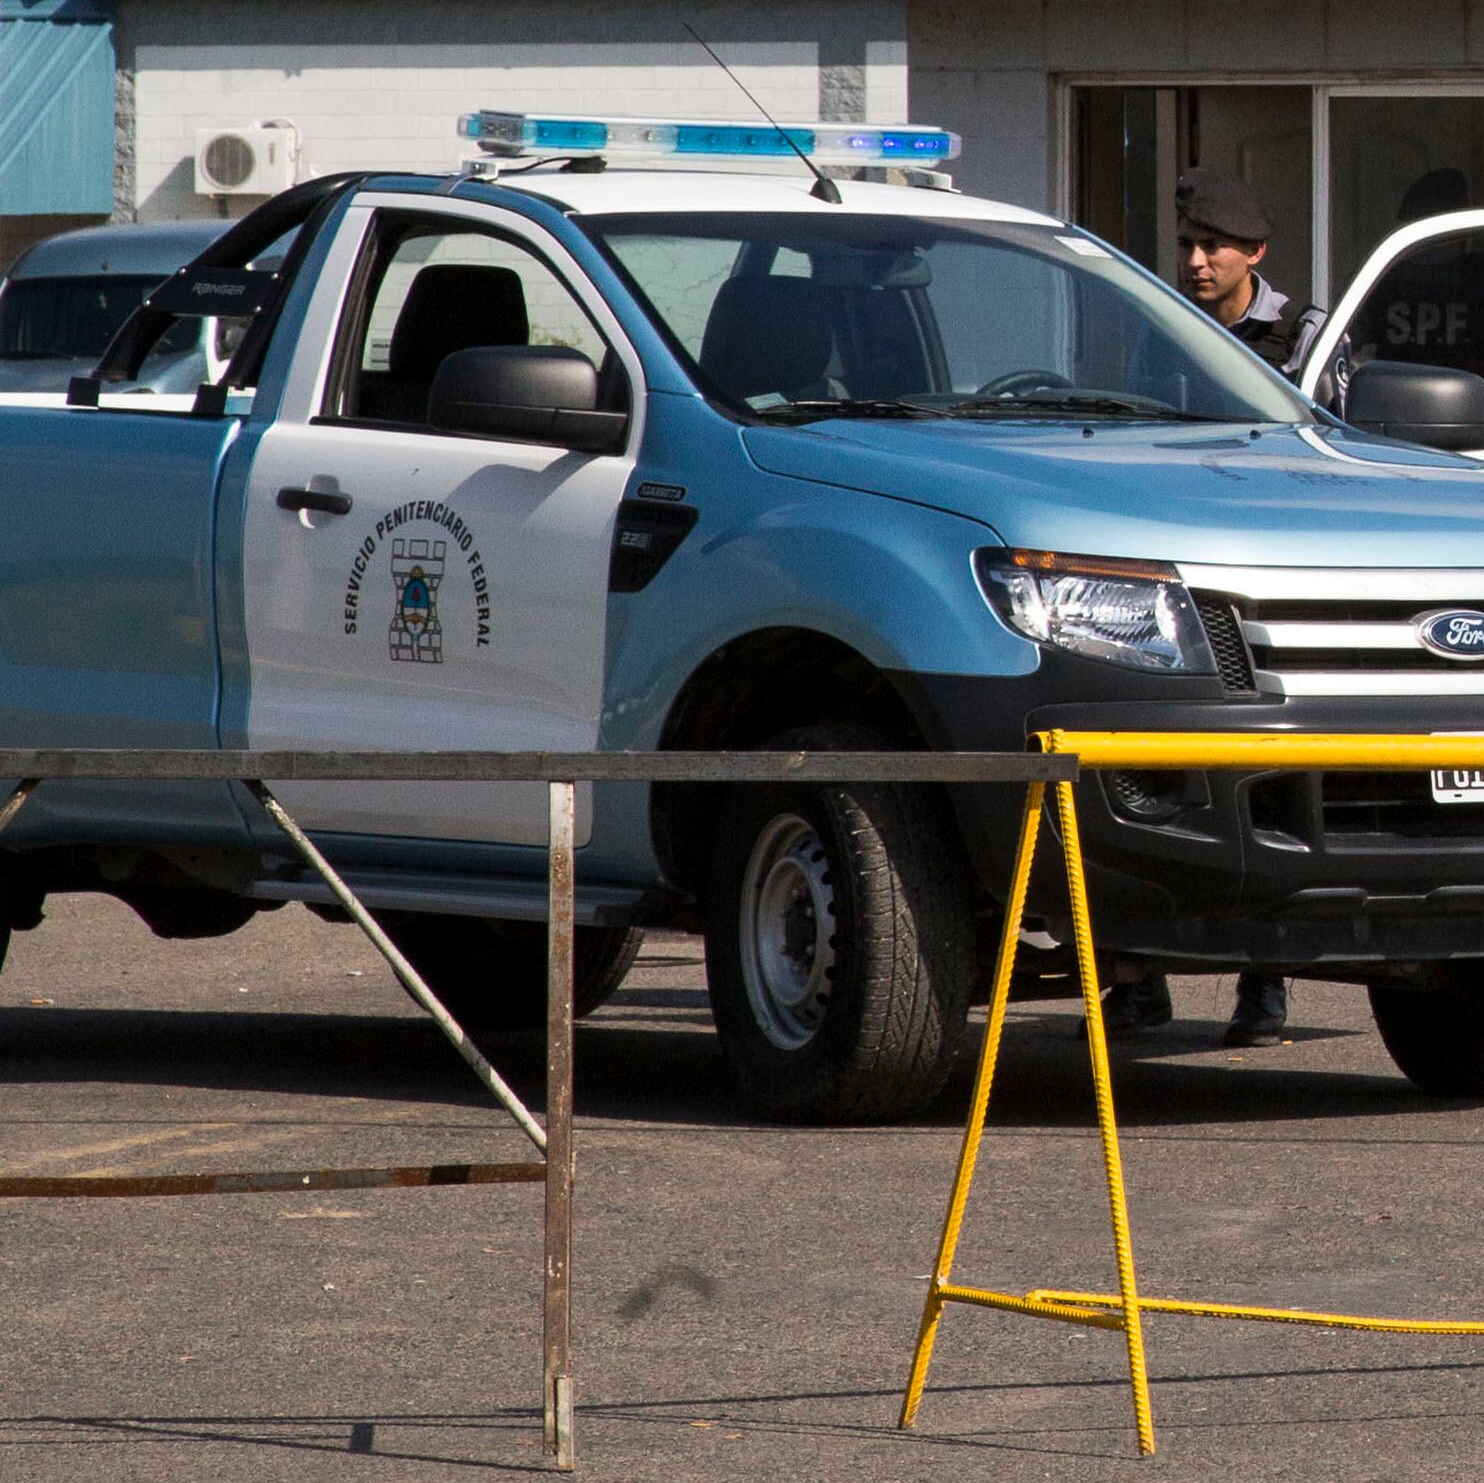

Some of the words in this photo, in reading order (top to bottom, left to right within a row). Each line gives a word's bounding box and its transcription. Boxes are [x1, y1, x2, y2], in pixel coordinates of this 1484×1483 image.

[344, 536, 377, 636] SERVICIO
[375, 500, 474, 552] PENITENCIARIO
[467, 550, 491, 648] FEDERAL
